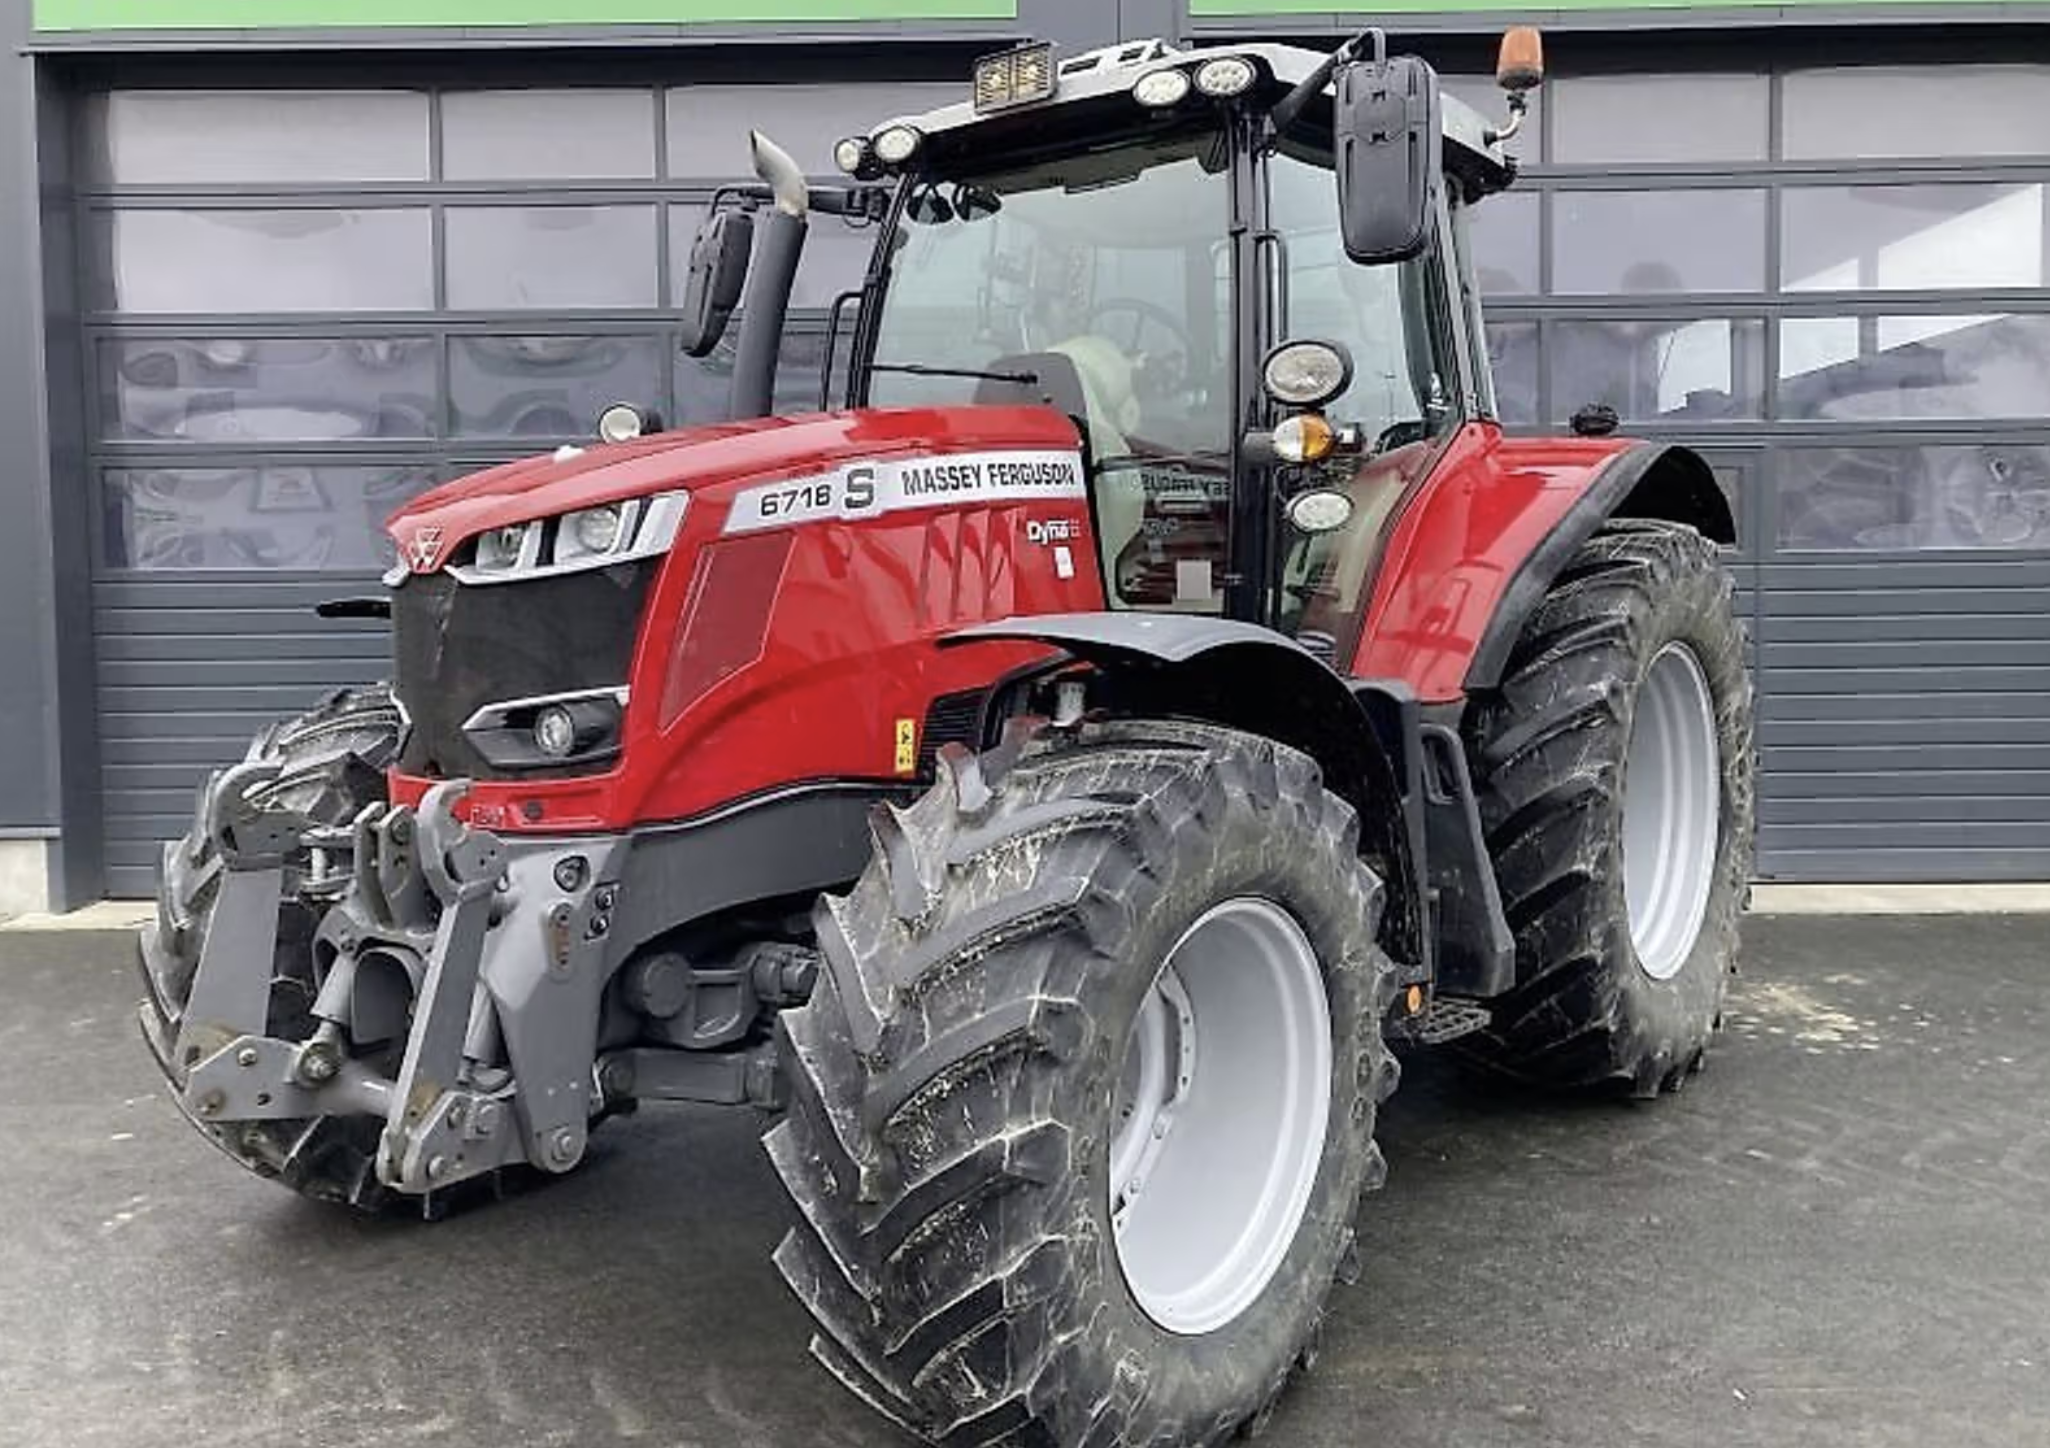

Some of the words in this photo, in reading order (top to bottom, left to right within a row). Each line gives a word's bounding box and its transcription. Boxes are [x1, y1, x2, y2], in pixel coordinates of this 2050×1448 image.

[761, 484, 831, 516] 6718
[844, 468, 875, 509] S
[901, 464, 981, 495] MASSEY
[987, 463, 1076, 487] FERGUSON
